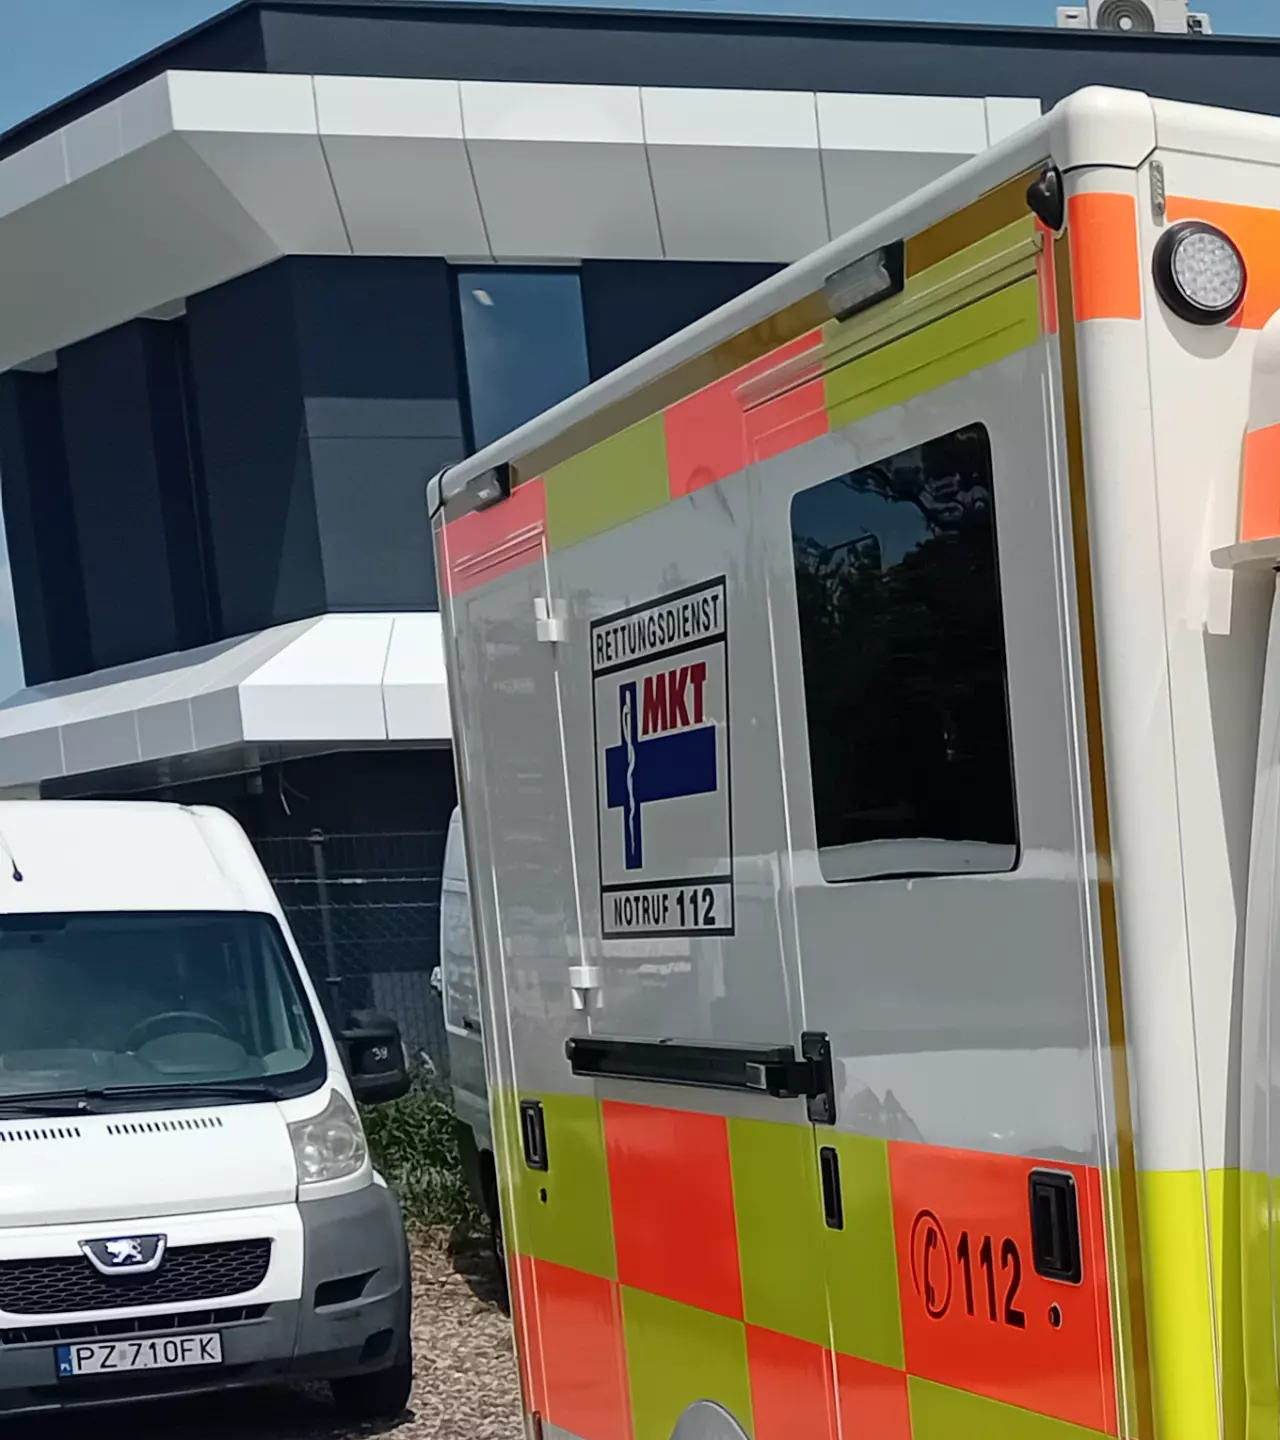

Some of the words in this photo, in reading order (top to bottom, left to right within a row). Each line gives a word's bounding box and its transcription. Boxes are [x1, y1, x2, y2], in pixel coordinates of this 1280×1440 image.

[596, 593, 720, 665] RETTUNGSDIENST
[641, 661, 707, 737] MKT
[613, 893, 669, 927] NOTRUF
[676, 887, 716, 927] 112
[956, 1230, 1026, 1329] 112
[76, 1343, 118, 1371] PZ
